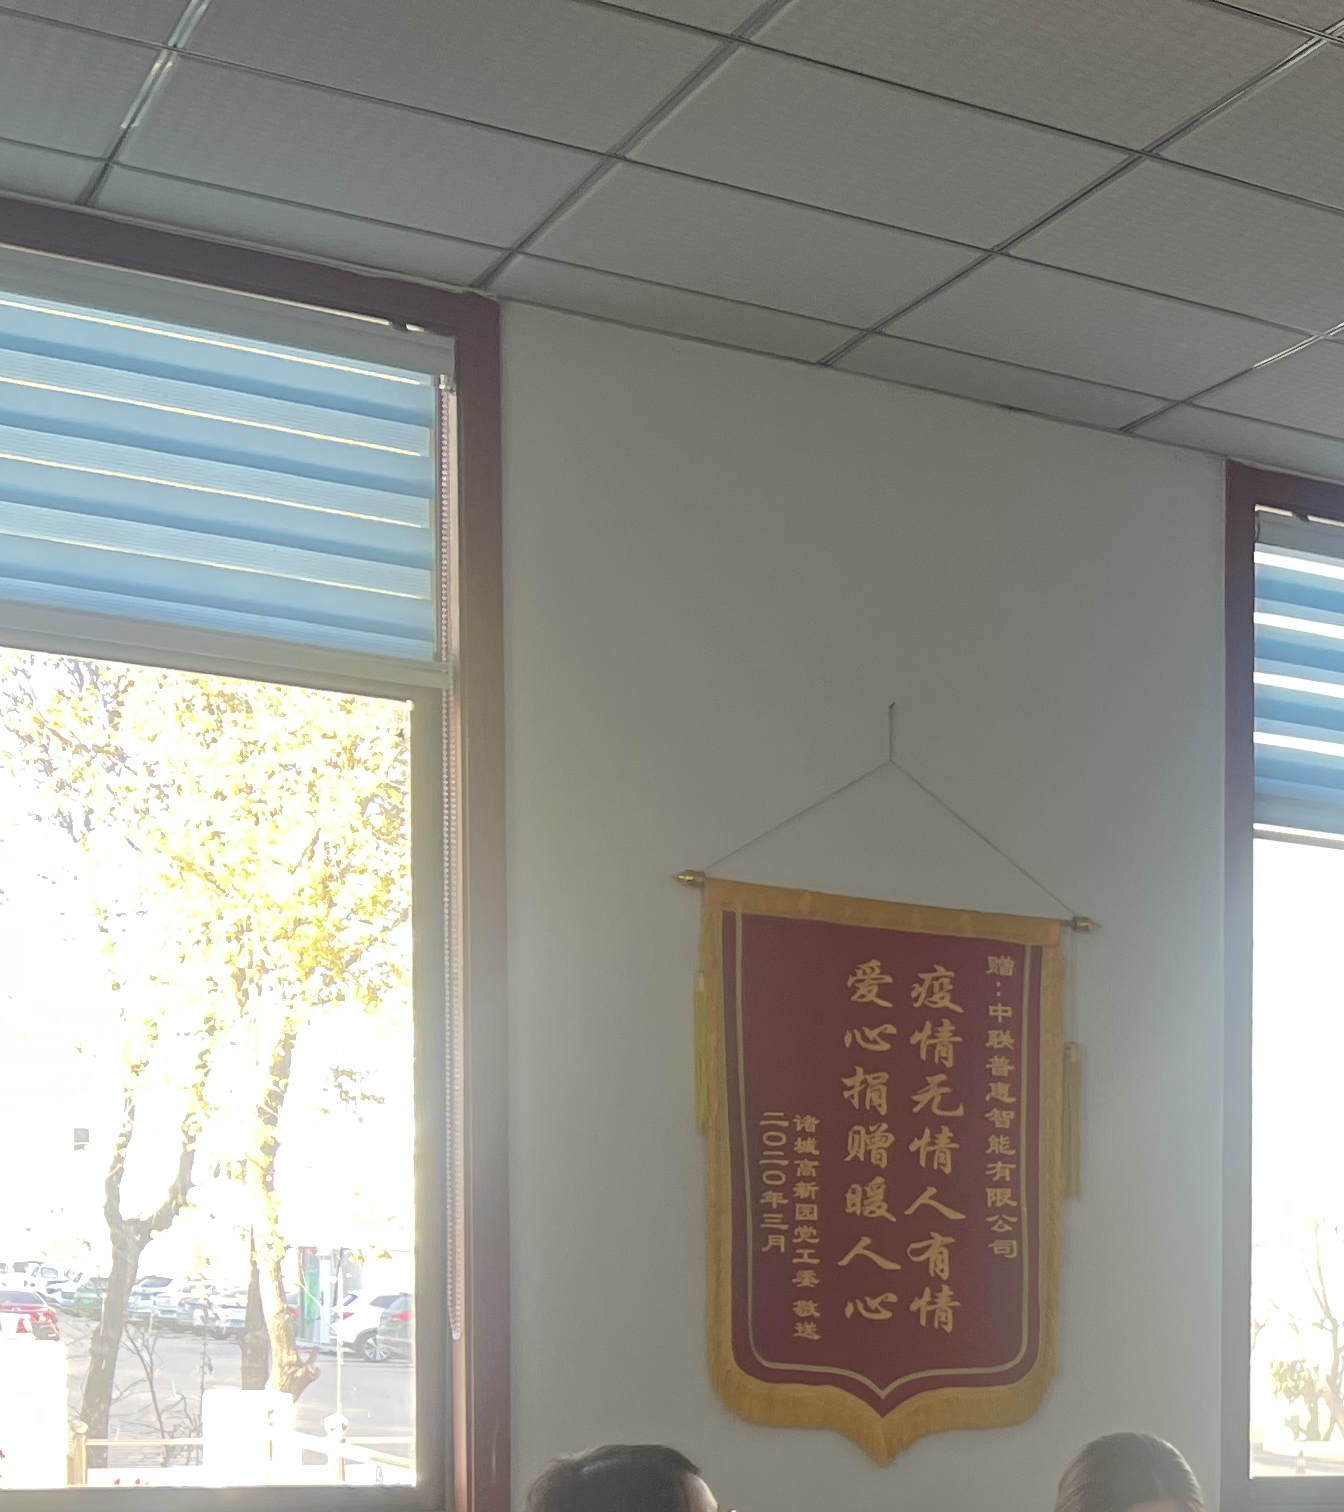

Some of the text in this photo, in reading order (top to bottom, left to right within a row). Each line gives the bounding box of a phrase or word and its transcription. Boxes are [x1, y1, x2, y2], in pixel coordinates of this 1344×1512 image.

[838, 958, 902, 1321] 爱心捐赠暖人心
[904, 963, 965, 1334] 疫情无情人有情
